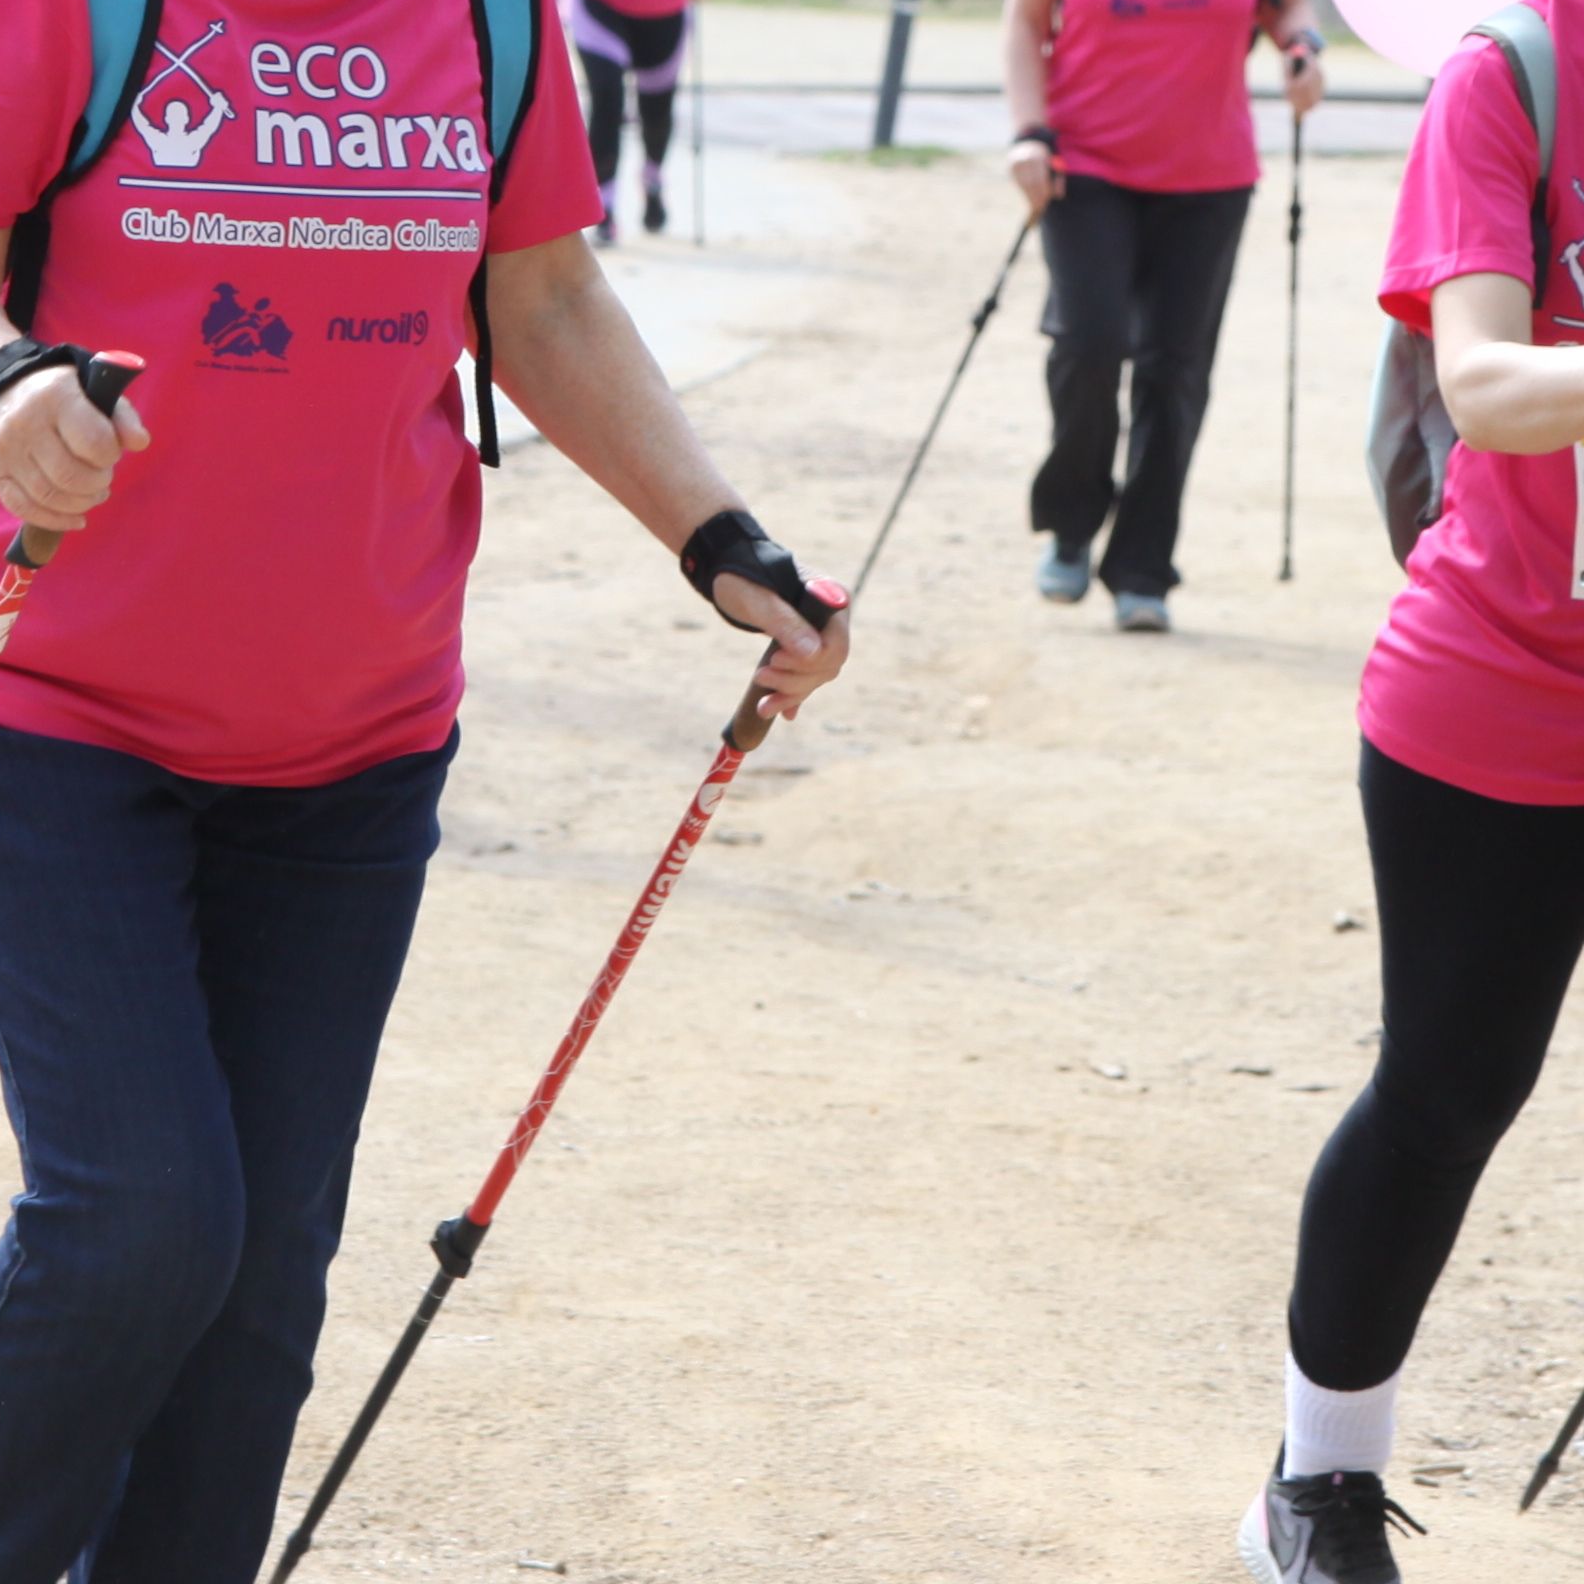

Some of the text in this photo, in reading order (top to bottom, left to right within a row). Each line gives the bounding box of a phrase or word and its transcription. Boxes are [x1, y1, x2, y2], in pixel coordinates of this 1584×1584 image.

[249, 41, 387, 98] eco
[255, 108, 486, 173] marxa
[123, 208, 480, 251] Club Marxa Nòrdica Collserola
